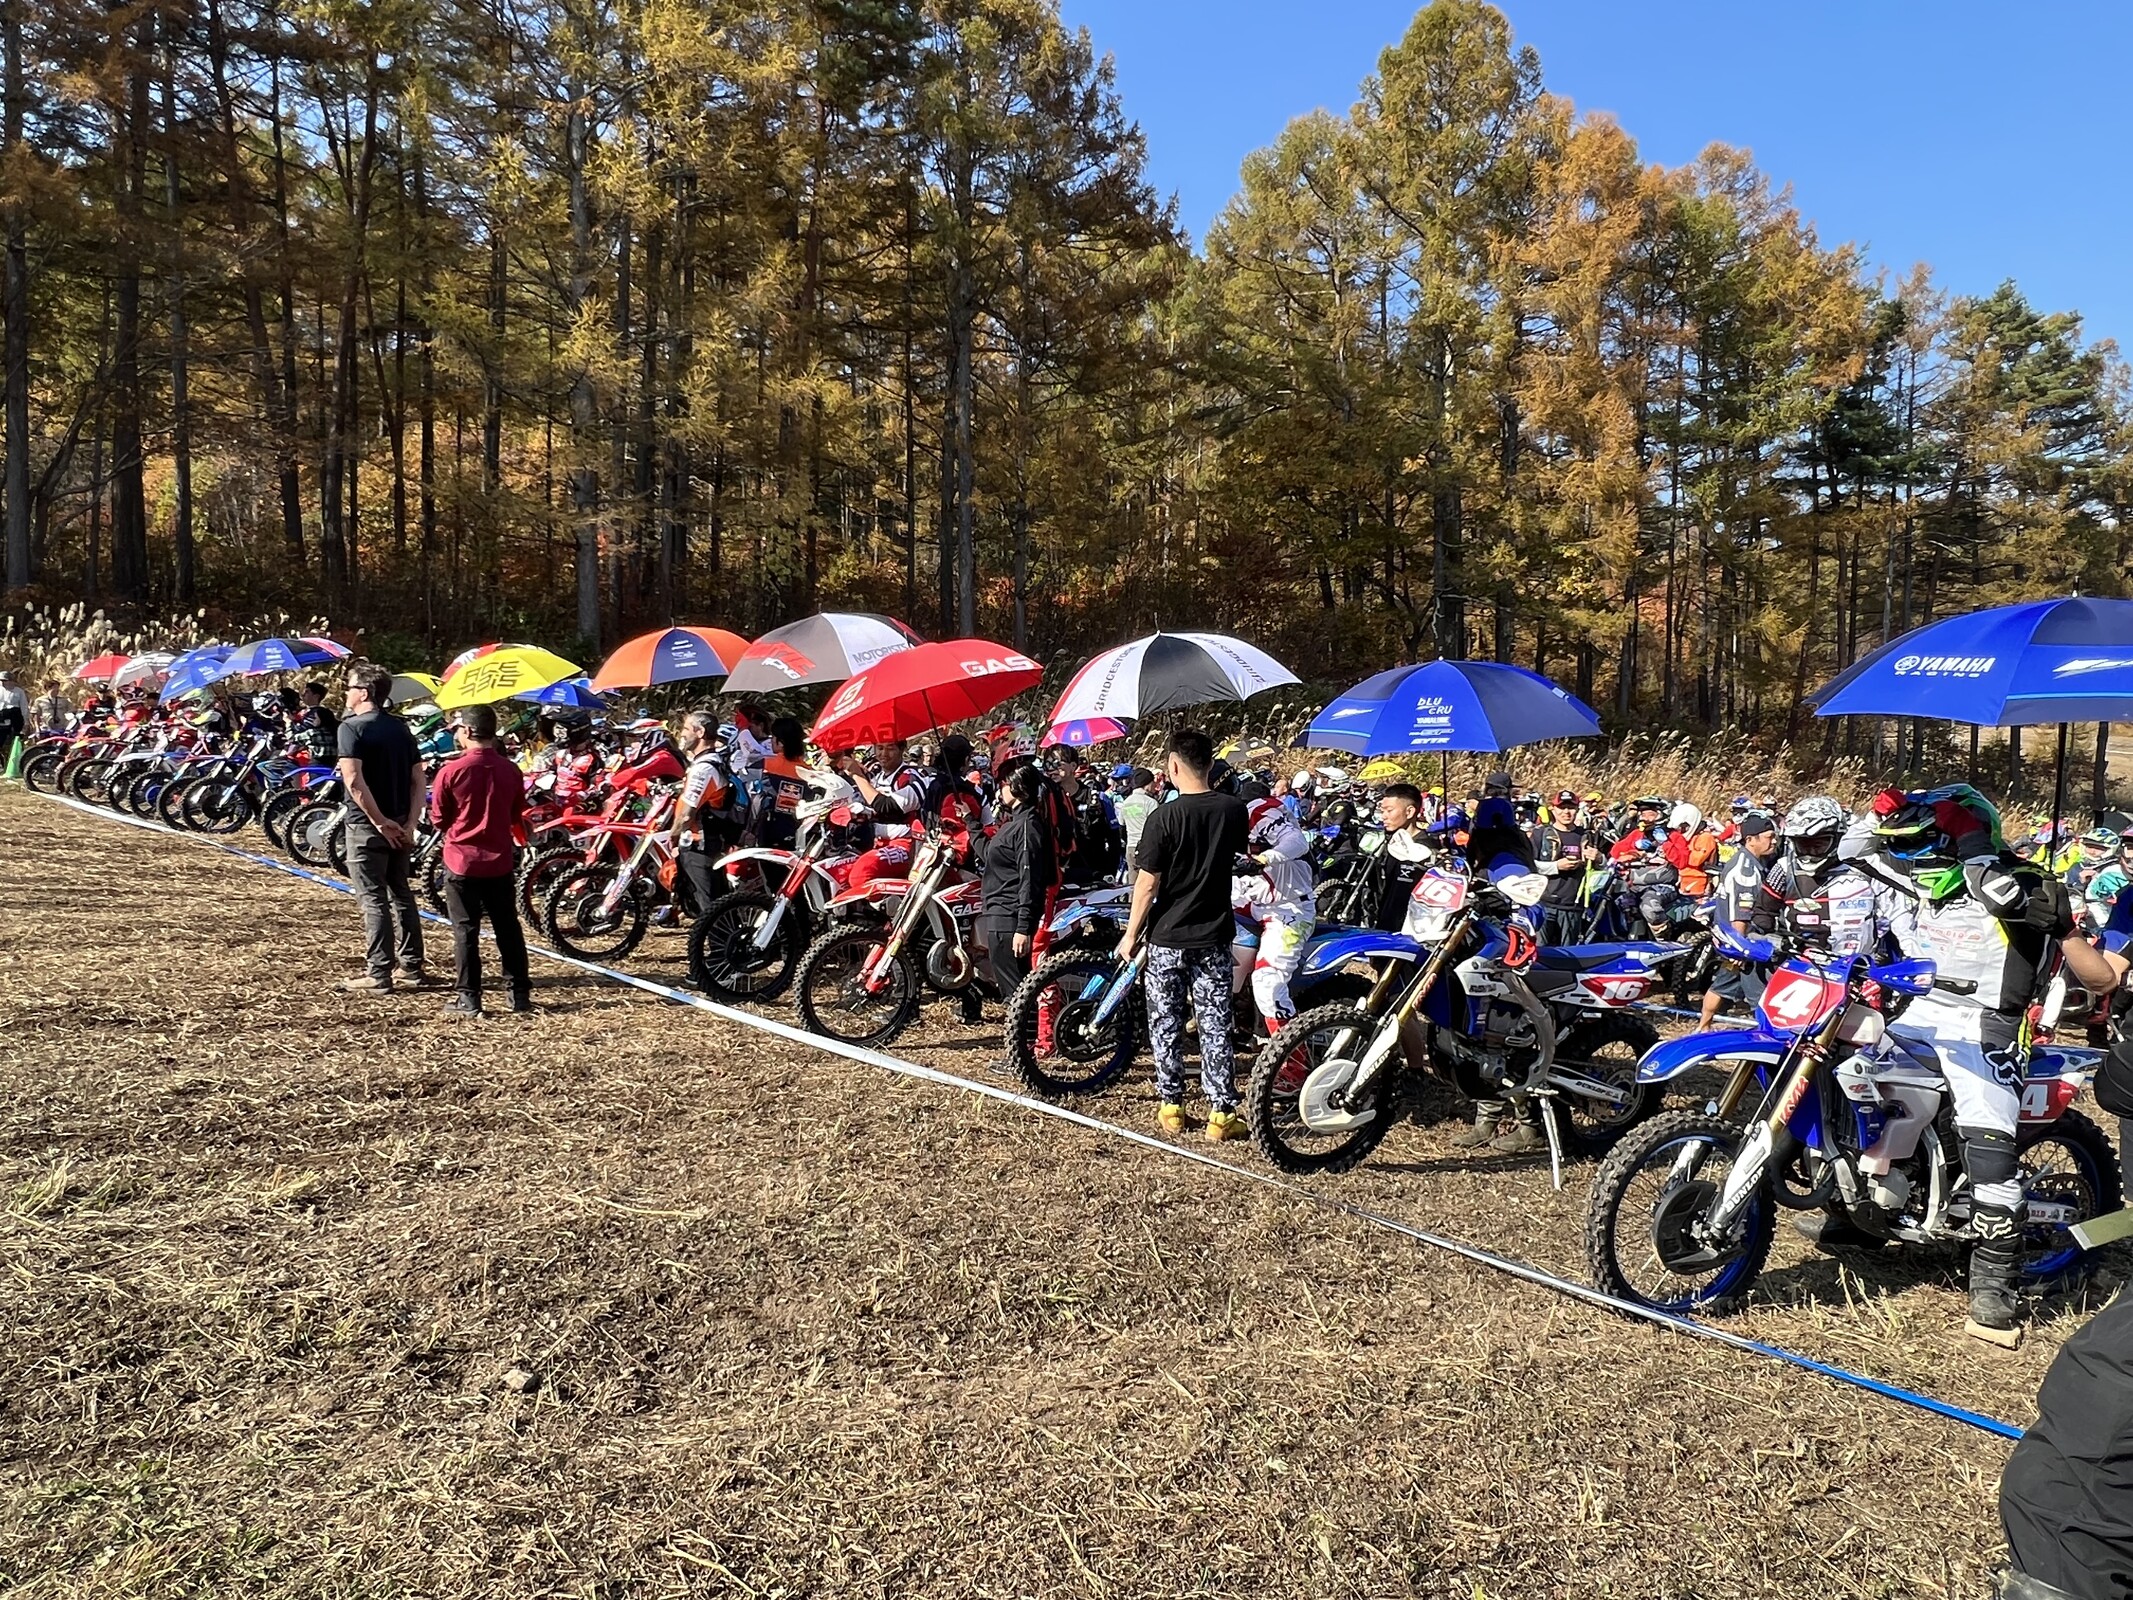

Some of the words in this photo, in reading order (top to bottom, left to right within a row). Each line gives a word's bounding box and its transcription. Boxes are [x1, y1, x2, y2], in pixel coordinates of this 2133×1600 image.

[1917, 656, 1996, 673] YAMAHA
[1415, 877, 1458, 903] 16
[1601, 981, 1644, 1000] 16
[1768, 979, 1823, 1020] 4
[2020, 1083, 2050, 1117] 4
